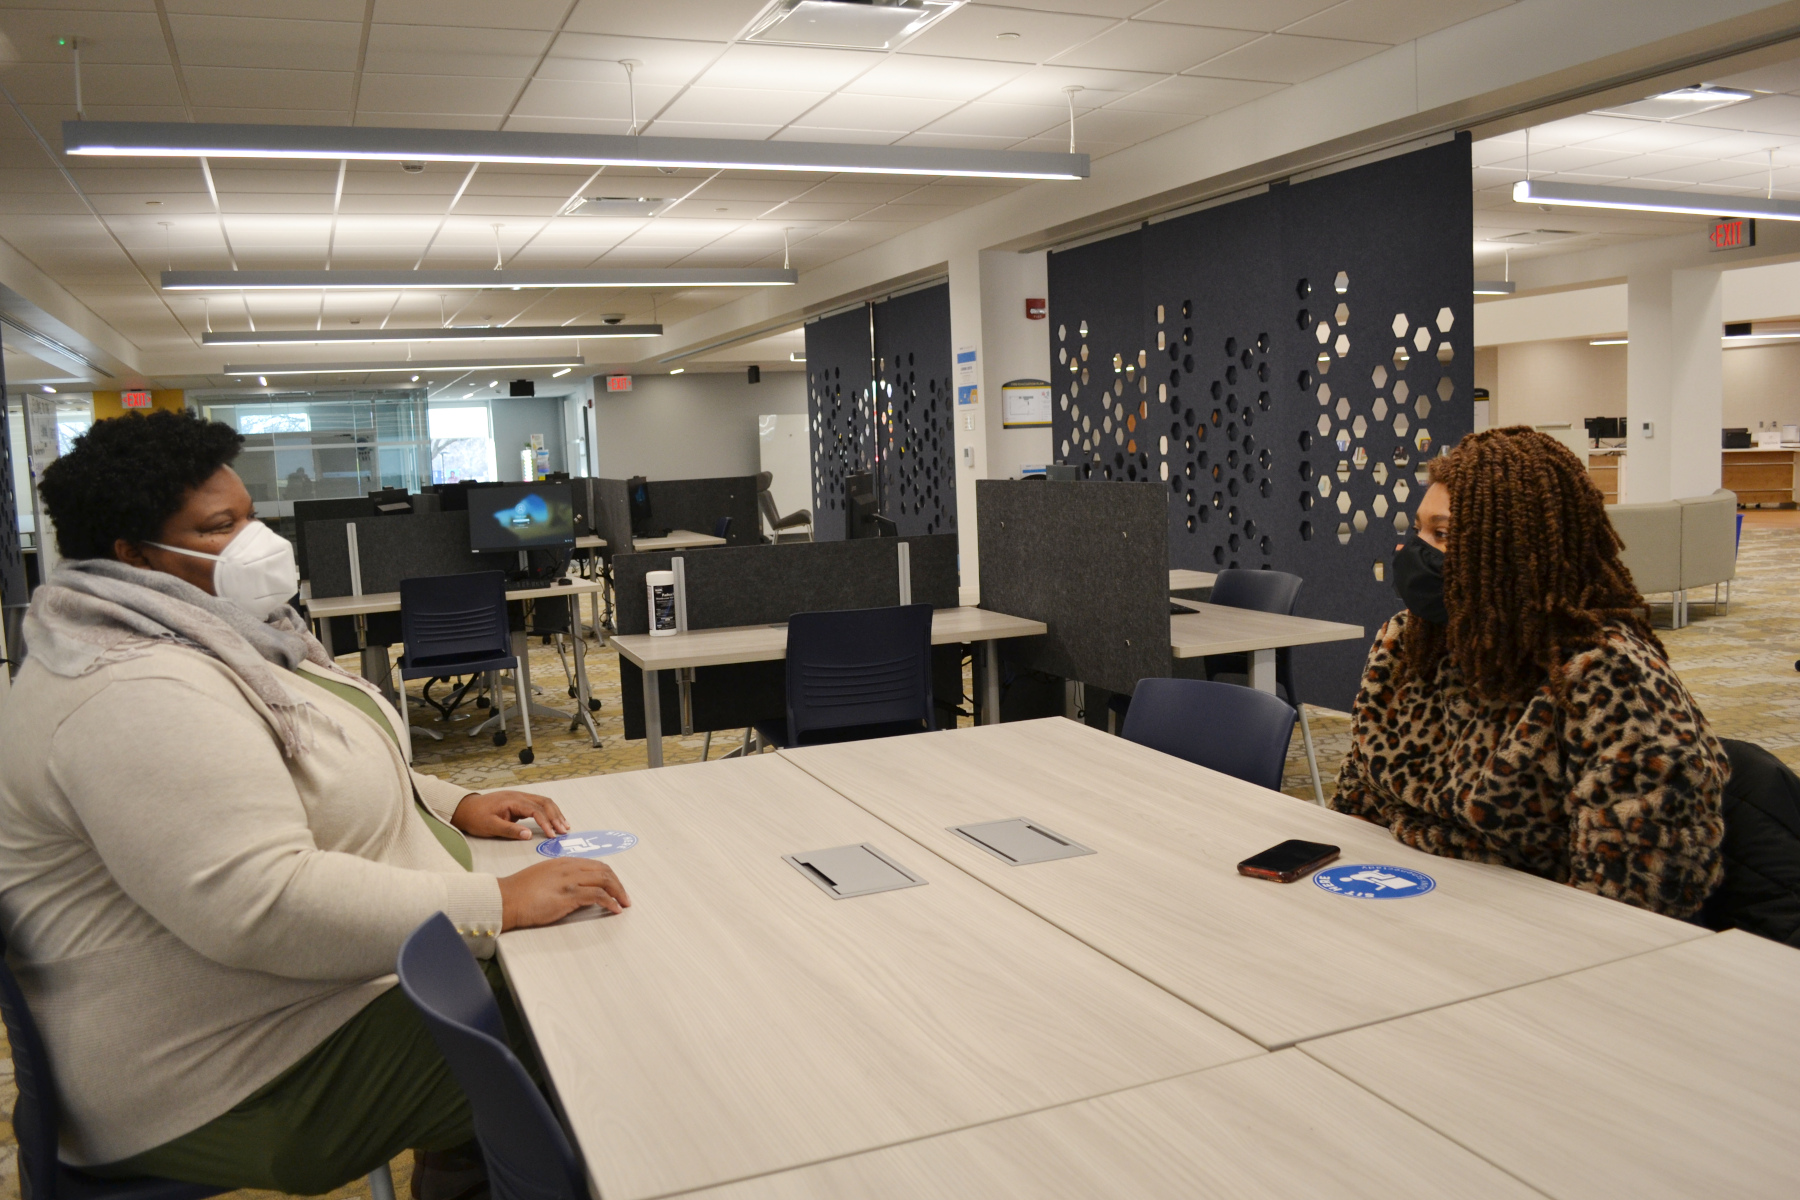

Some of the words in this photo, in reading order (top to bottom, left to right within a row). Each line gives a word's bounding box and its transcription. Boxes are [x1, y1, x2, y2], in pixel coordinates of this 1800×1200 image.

[1716, 221, 1743, 247] EXIT
[611, 377, 627, 390] EXIT
[127, 393, 146, 407] EXIT
[1318, 875, 1343, 892] HERE
